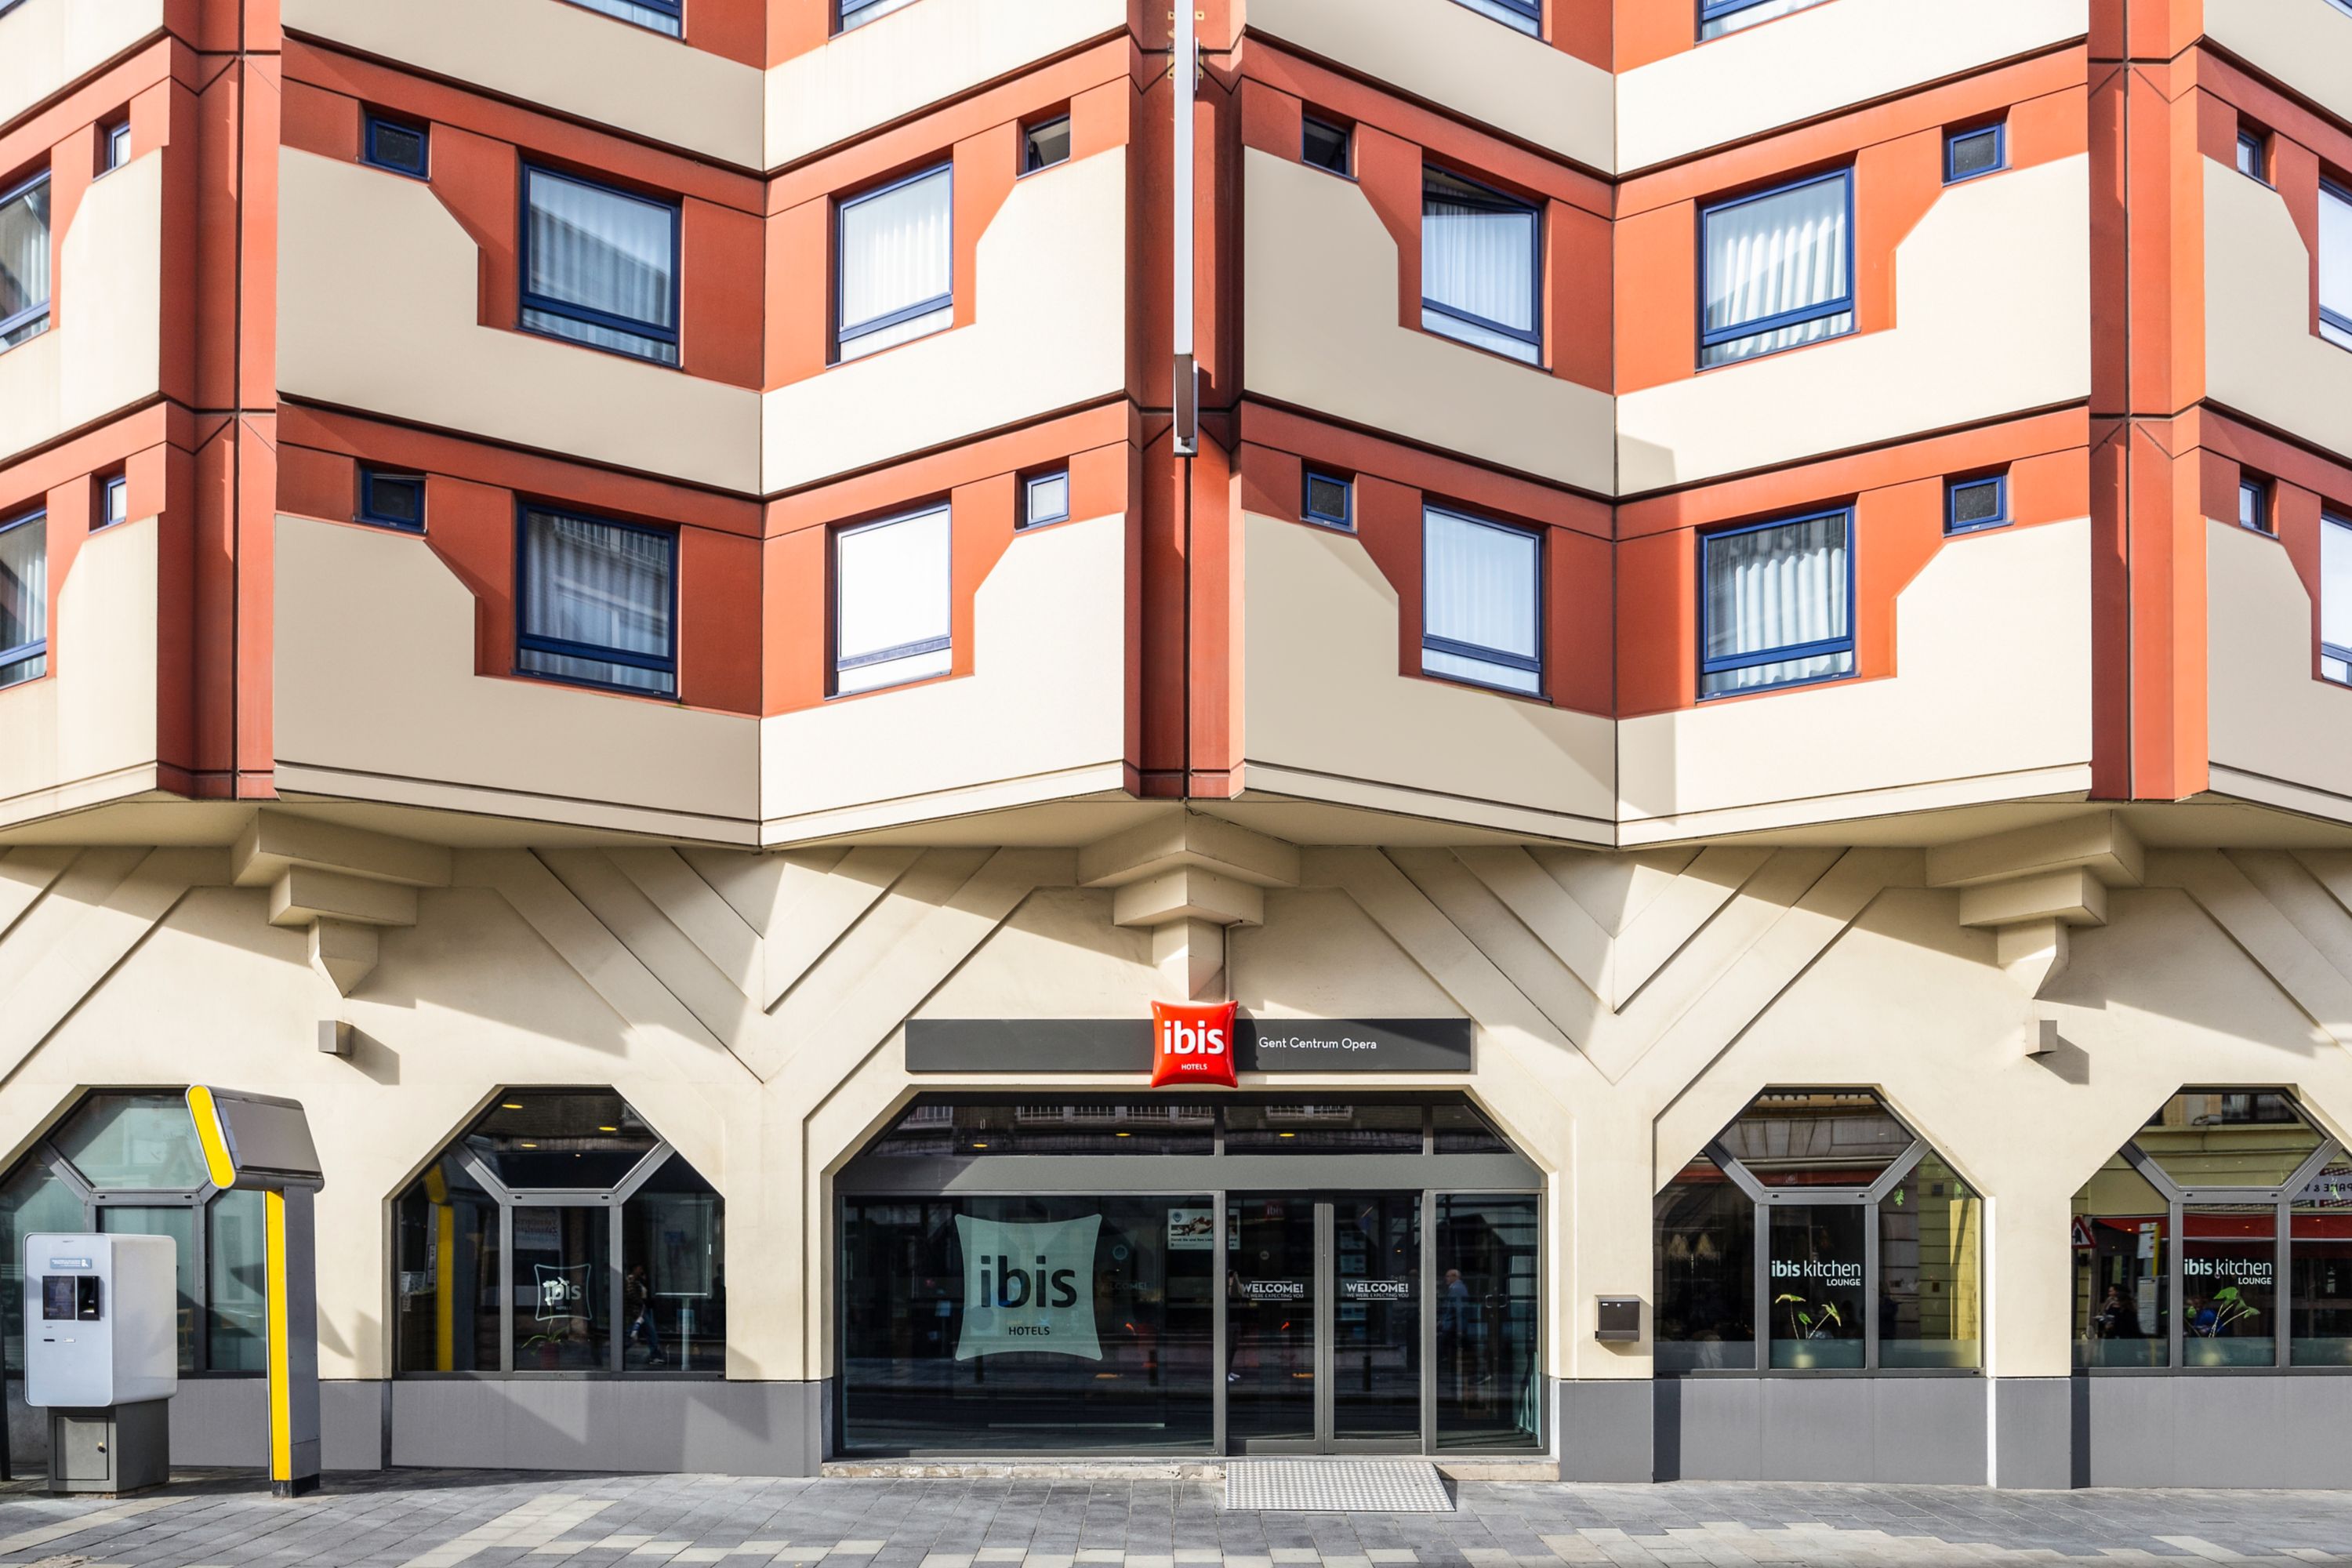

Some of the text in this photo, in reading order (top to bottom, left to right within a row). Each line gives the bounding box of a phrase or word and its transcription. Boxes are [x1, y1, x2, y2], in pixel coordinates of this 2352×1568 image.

[1163, 1020, 1225, 1054] ibis
[1258, 1036, 1377, 1052] Gent Centrum Opera
[1771, 1260, 1861, 1277] ibis kitchen
[2184, 1258, 2272, 1276] ibis kitchen
[981, 1255, 1078, 1308] ibis
[1242, 1283, 1304, 1293] WELCOME!
[1346, 1283, 1409, 1293] WELCOME!
[1009, 1327, 1051, 1336] HOTELS
